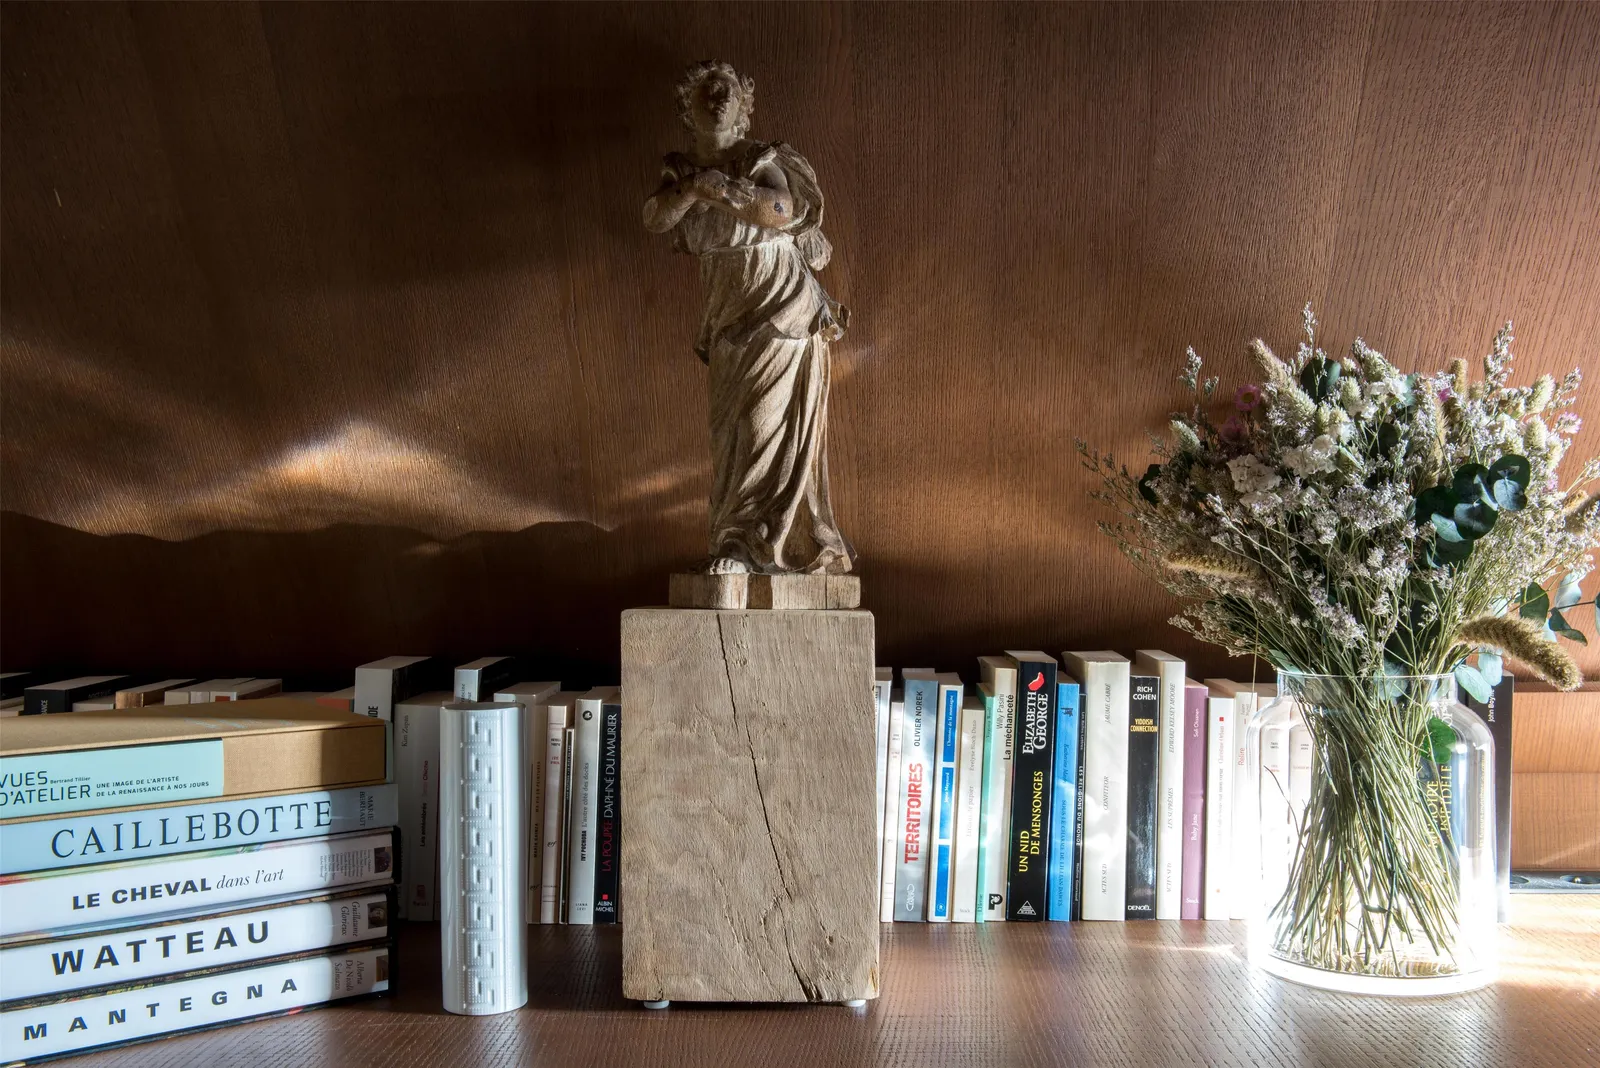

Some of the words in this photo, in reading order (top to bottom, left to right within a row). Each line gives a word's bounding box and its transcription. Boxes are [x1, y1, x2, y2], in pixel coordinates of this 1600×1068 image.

[914, 717, 922, 747] OLIVIER
[1004, 694, 1014, 747] méchanceté
[1022, 691, 1037, 755] ELIZABETH
[1033, 693, 1048, 750] GEORGE
[401, 734, 409, 747] Kim
[606, 713, 617, 759] MAURIER
[605, 761, 615, 776] DU
[1003, 748, 1011, 760] La
[0, 770, 48, 789] VUES
[119, 786, 165, 795] RENAISSANCE
[147, 776, 179, 784] L'ARTISTE
[603, 778, 614, 818] DAPHNÉ
[1031, 770, 1043, 838] MENSONGES
[904, 763, 923, 864] TERRITOIRES
[1077, 812, 1082, 821] DU
[1191, 813, 1199, 826] Jane
[51, 800, 333, 859] CAILLEBOTTE
[602, 819, 613, 856] POUPÉE
[1020, 830, 1030, 852] NID
[1031, 839, 1040, 855] DE
[600, 859, 611, 872] LA
[1019, 855, 1028, 872] UN
[72, 892, 100, 910] LE
[112, 877, 212, 905] CHEVAL
[216, 874, 250, 890] dans
[255, 867, 284, 883] l'art
[340, 905, 350, 935] Glorieux
[352, 901, 361, 937] Guillaume
[51, 920, 269, 976] WATTEAU
[346, 959, 353, 969] De
[23, 978, 298, 1041] MANTEGNA
